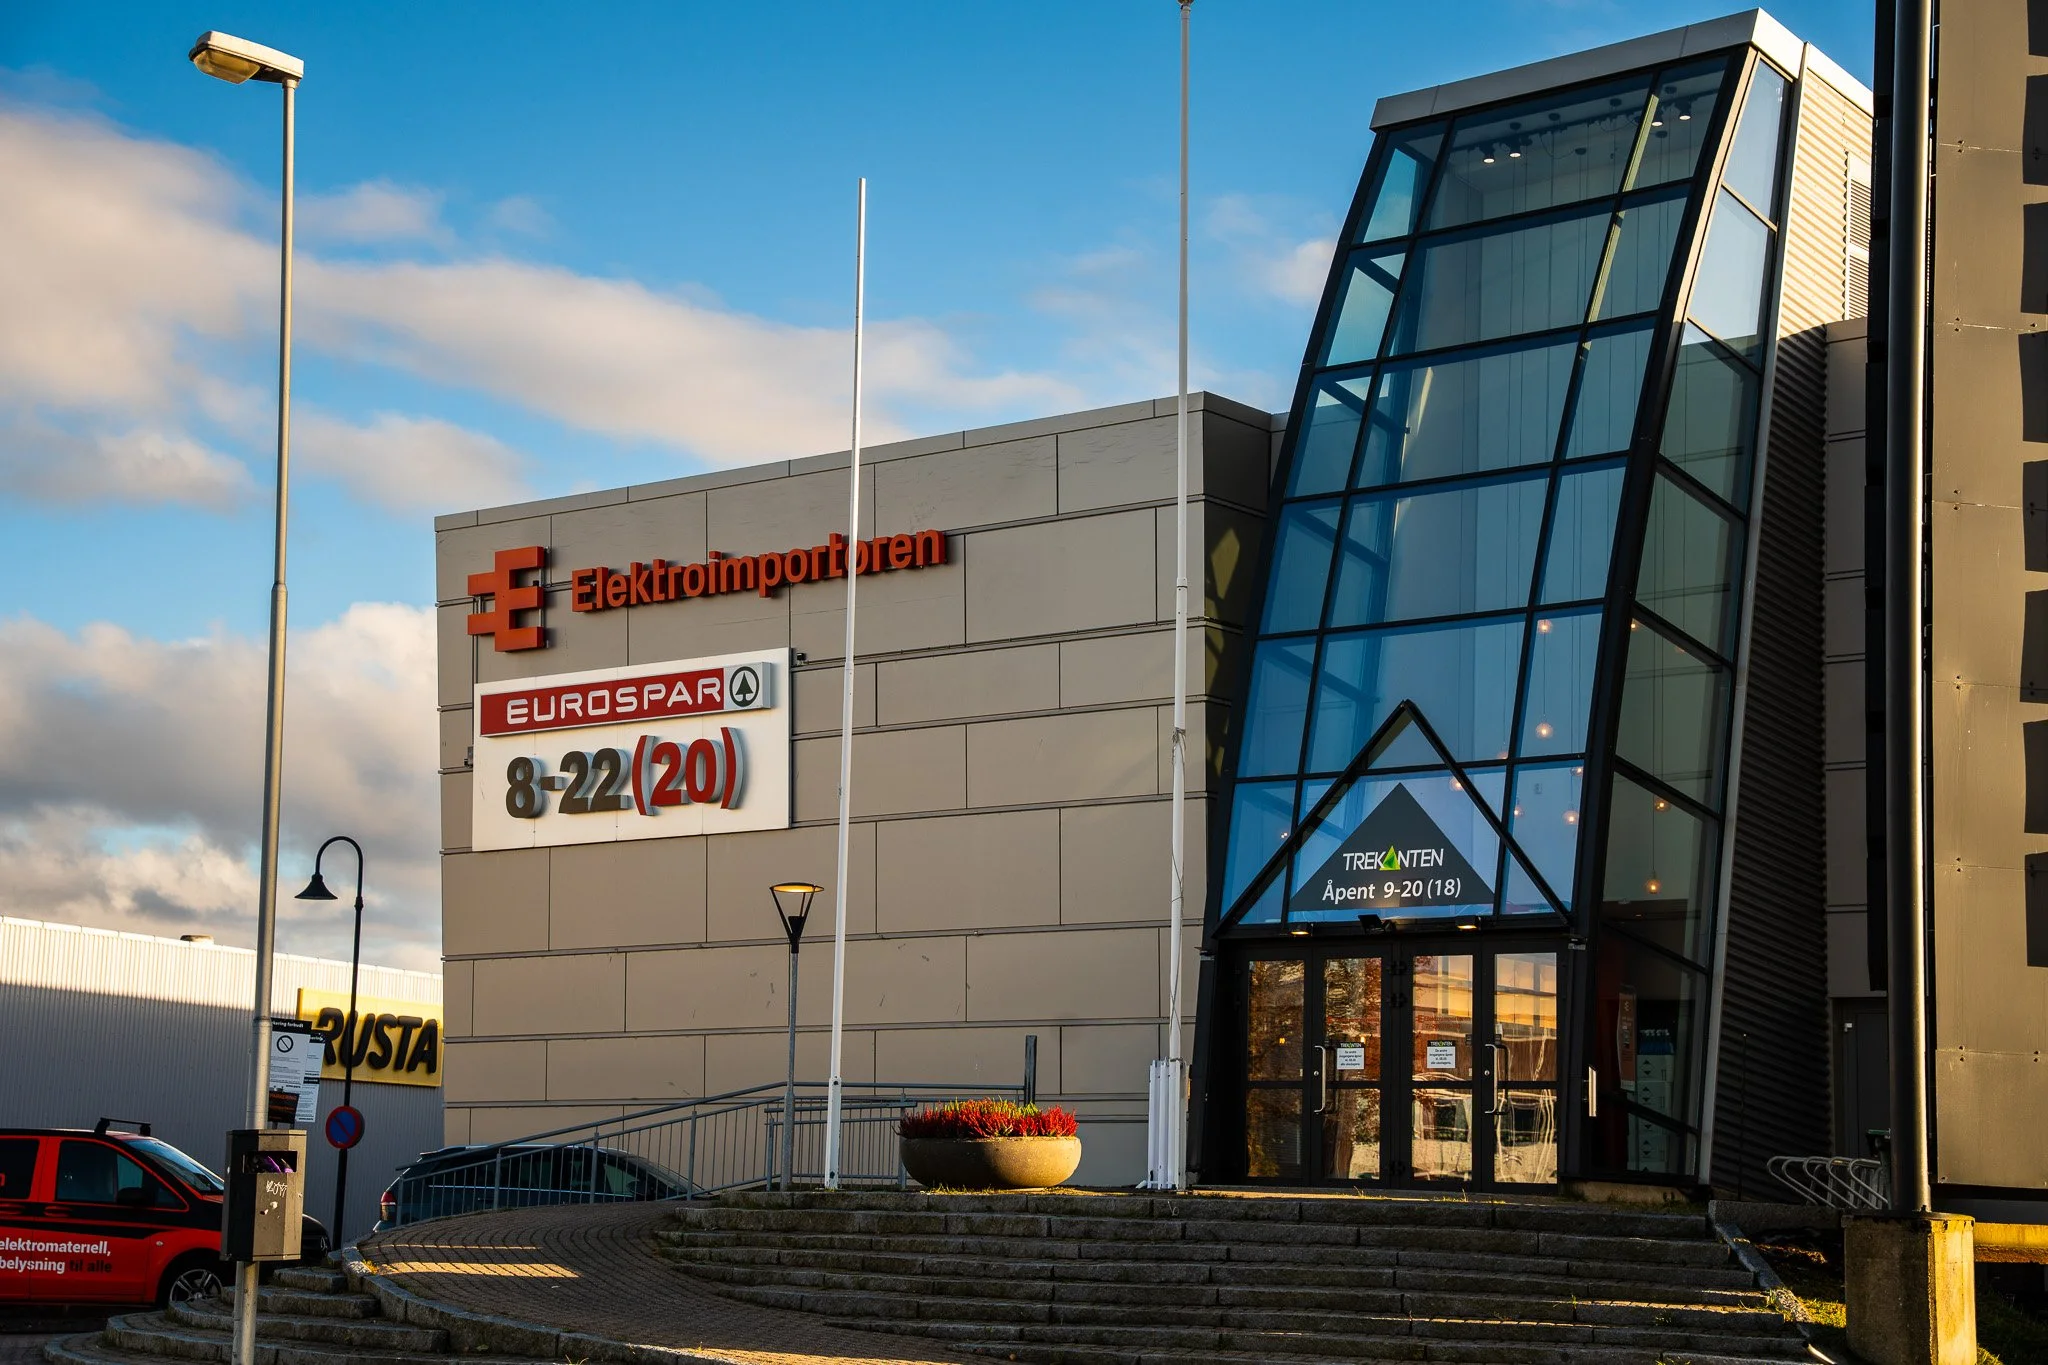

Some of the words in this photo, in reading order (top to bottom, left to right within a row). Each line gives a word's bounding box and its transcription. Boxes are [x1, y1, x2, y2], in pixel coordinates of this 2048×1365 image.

[572, 528, 946, 612] Elektroimportøren
[506, 676, 722, 725] EUROSPAR
[1322, 879, 1376, 905] Åpent
[1383, 880, 1424, 900] 9-20
[1427, 877, 1462, 899] (18)
[315, 1007, 439, 1075] RUSTA
[87, 1259, 112, 1274] alle
